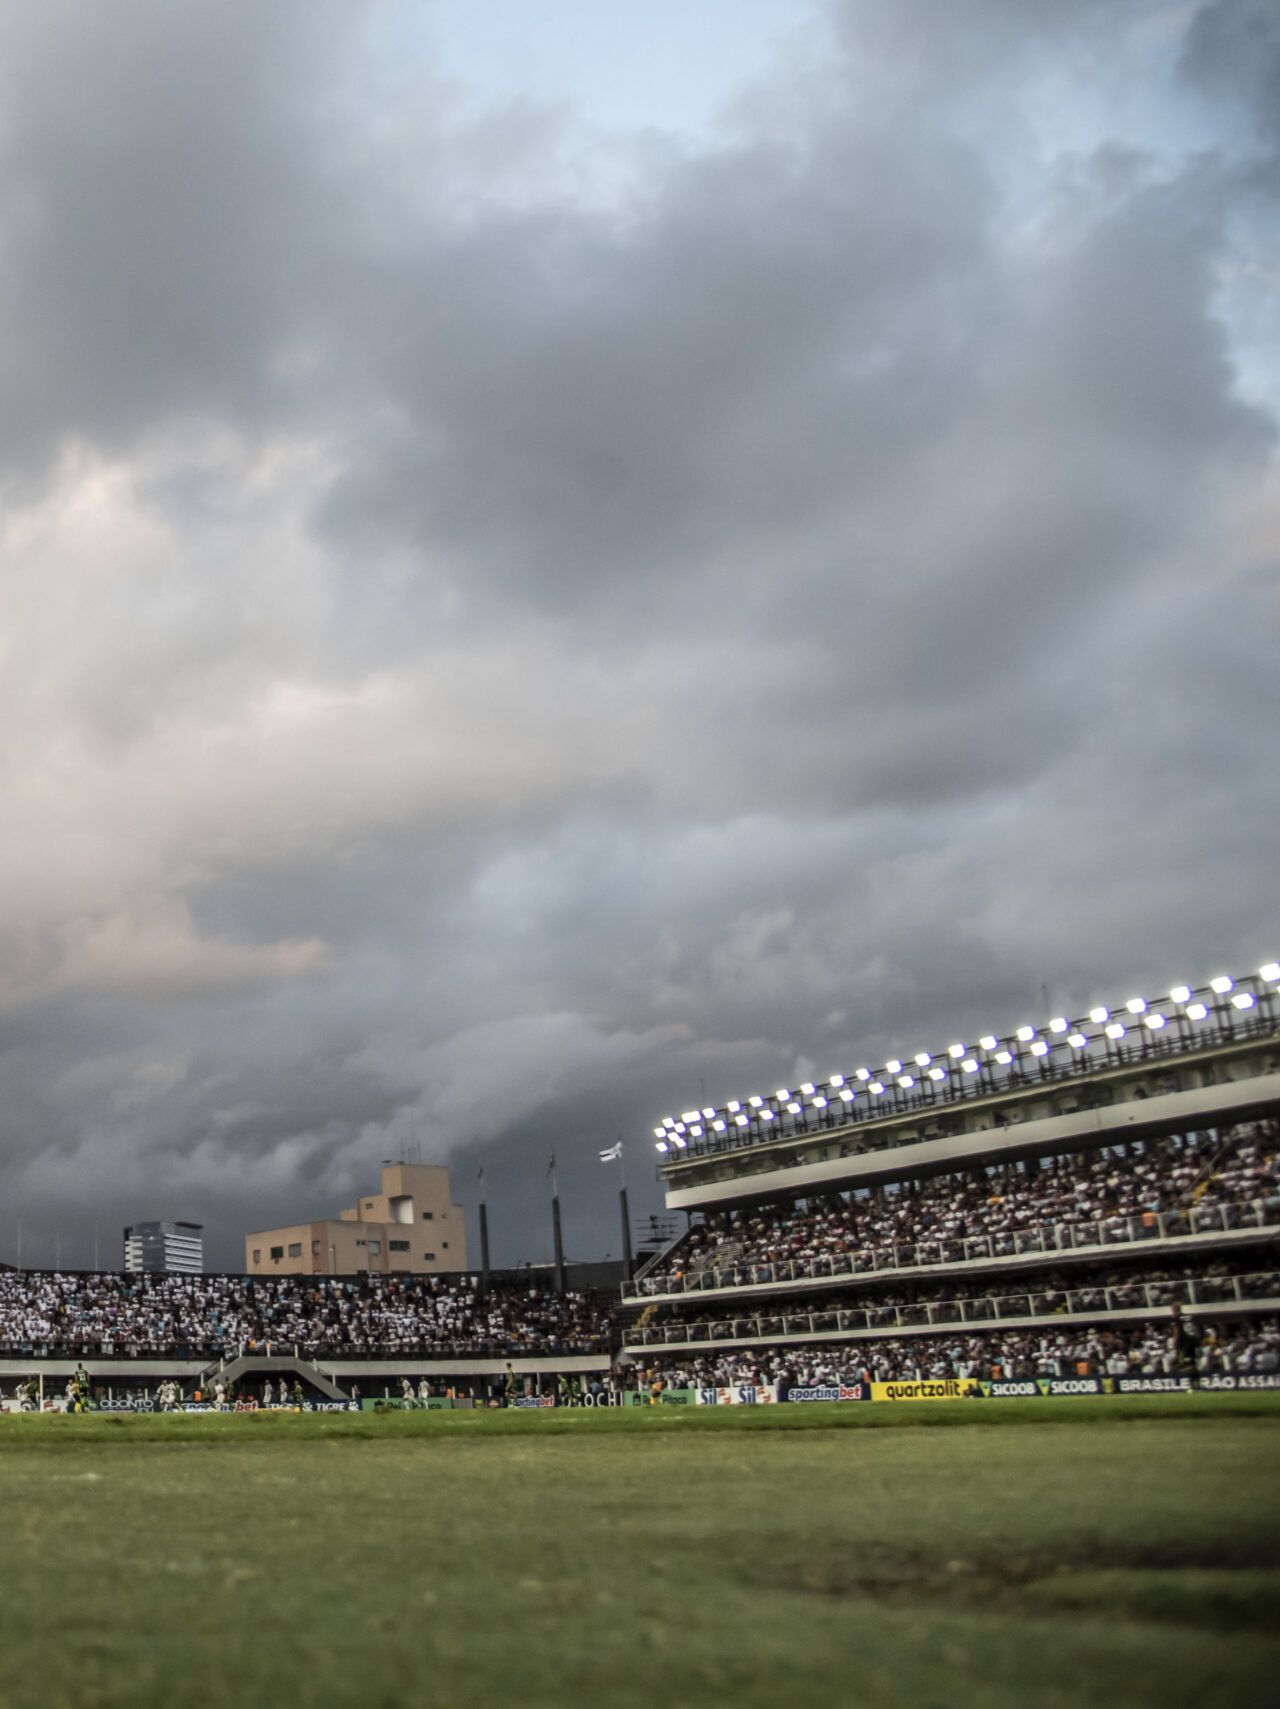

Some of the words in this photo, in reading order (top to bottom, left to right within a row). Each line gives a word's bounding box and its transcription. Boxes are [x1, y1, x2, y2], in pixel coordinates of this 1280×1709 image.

[886, 1381, 960, 1400] quartzolit
[992, 1383, 1036, 1395] SICOOB
[1051, 1380, 1097, 1393] SICOOB
[1120, 1374, 1235, 1391] BRASILERÃO
[700, 1388, 717, 1405] Sil
[739, 1387, 756, 1404] Sil
[788, 1384, 861, 1401] sportingbet
[100, 1400, 154, 1408] ODONTO
[315, 1402, 347, 1411] TIGRE
